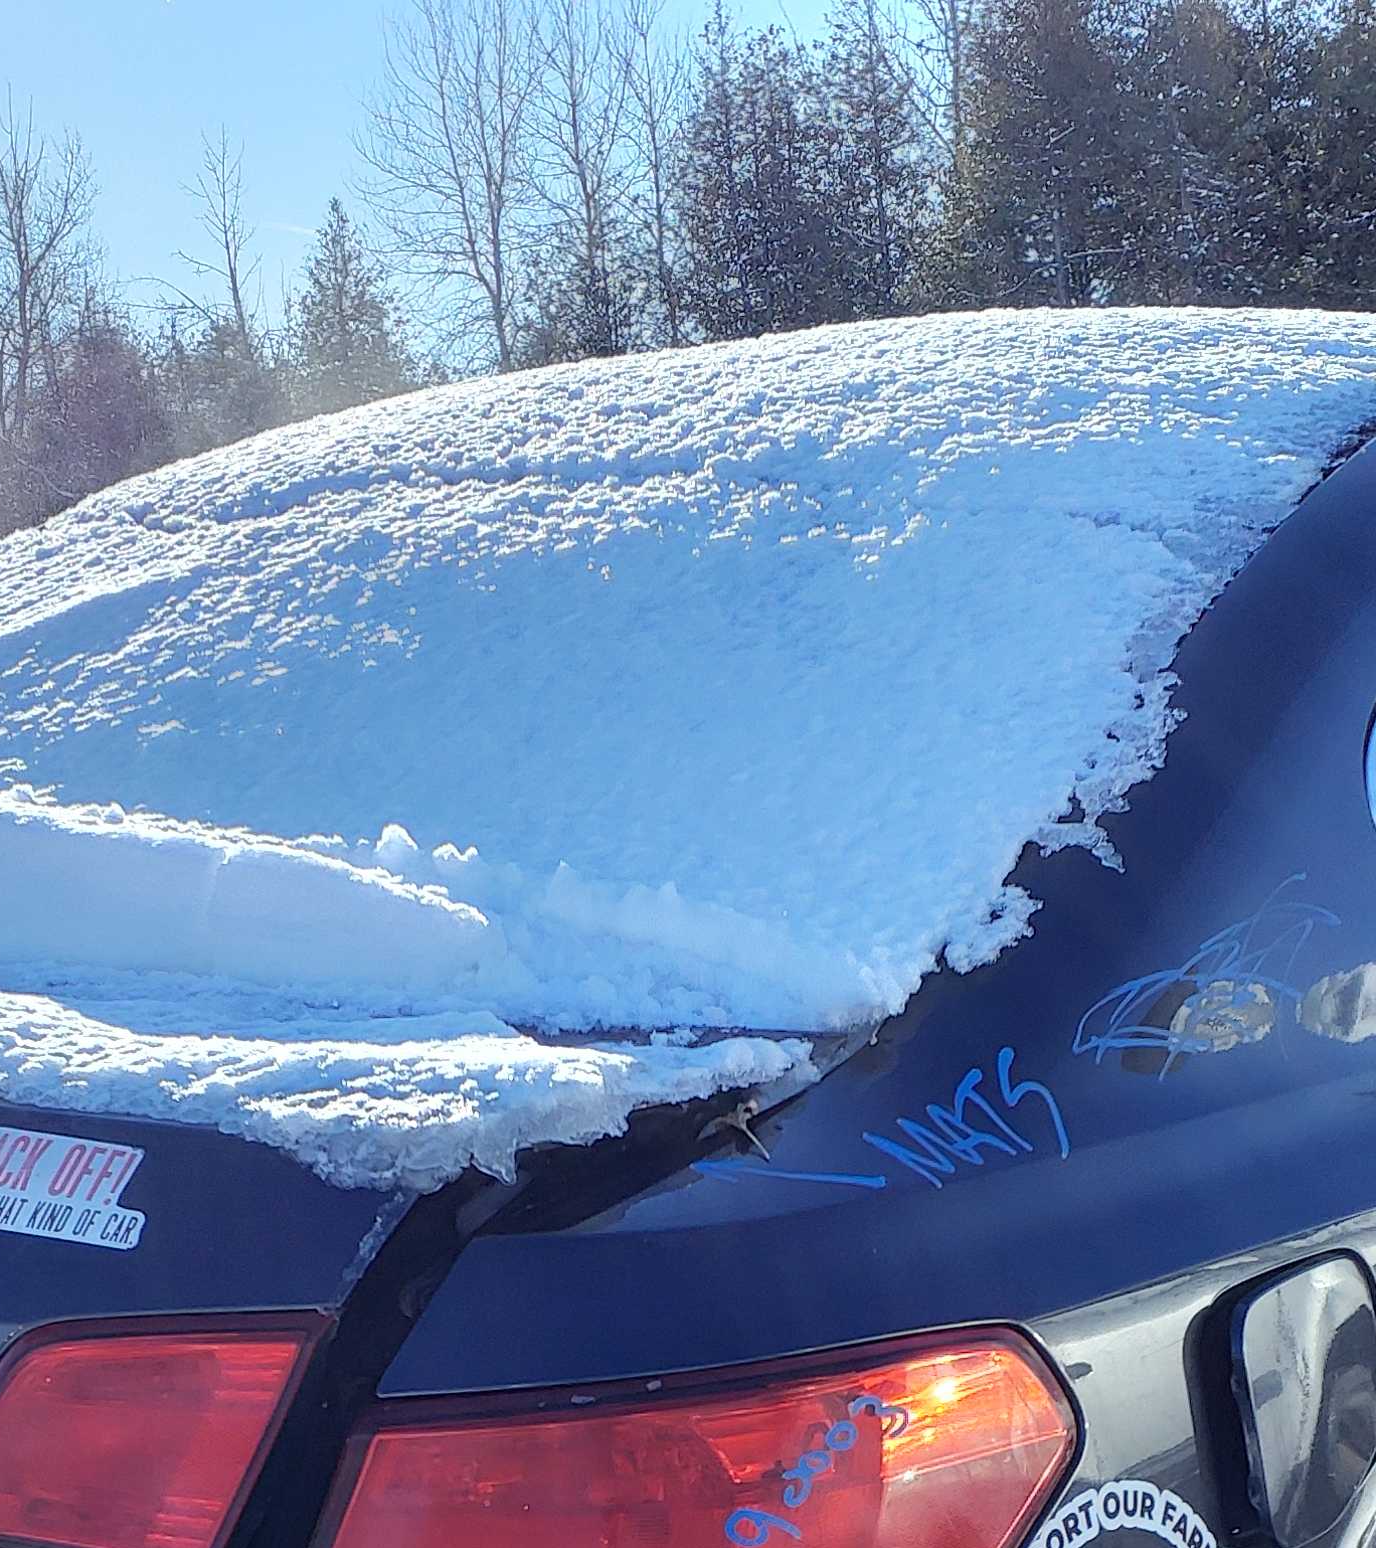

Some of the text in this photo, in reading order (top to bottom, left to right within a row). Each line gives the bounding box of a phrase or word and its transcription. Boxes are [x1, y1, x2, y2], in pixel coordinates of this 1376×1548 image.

[48, 1144, 139, 1206] OFF!
[27, 1199, 73, 1233] KIND
[73, 1209, 101, 1237] OF
[100, 1213, 141, 1245] CAR.
[1102, 1490, 1156, 1521] OUR
